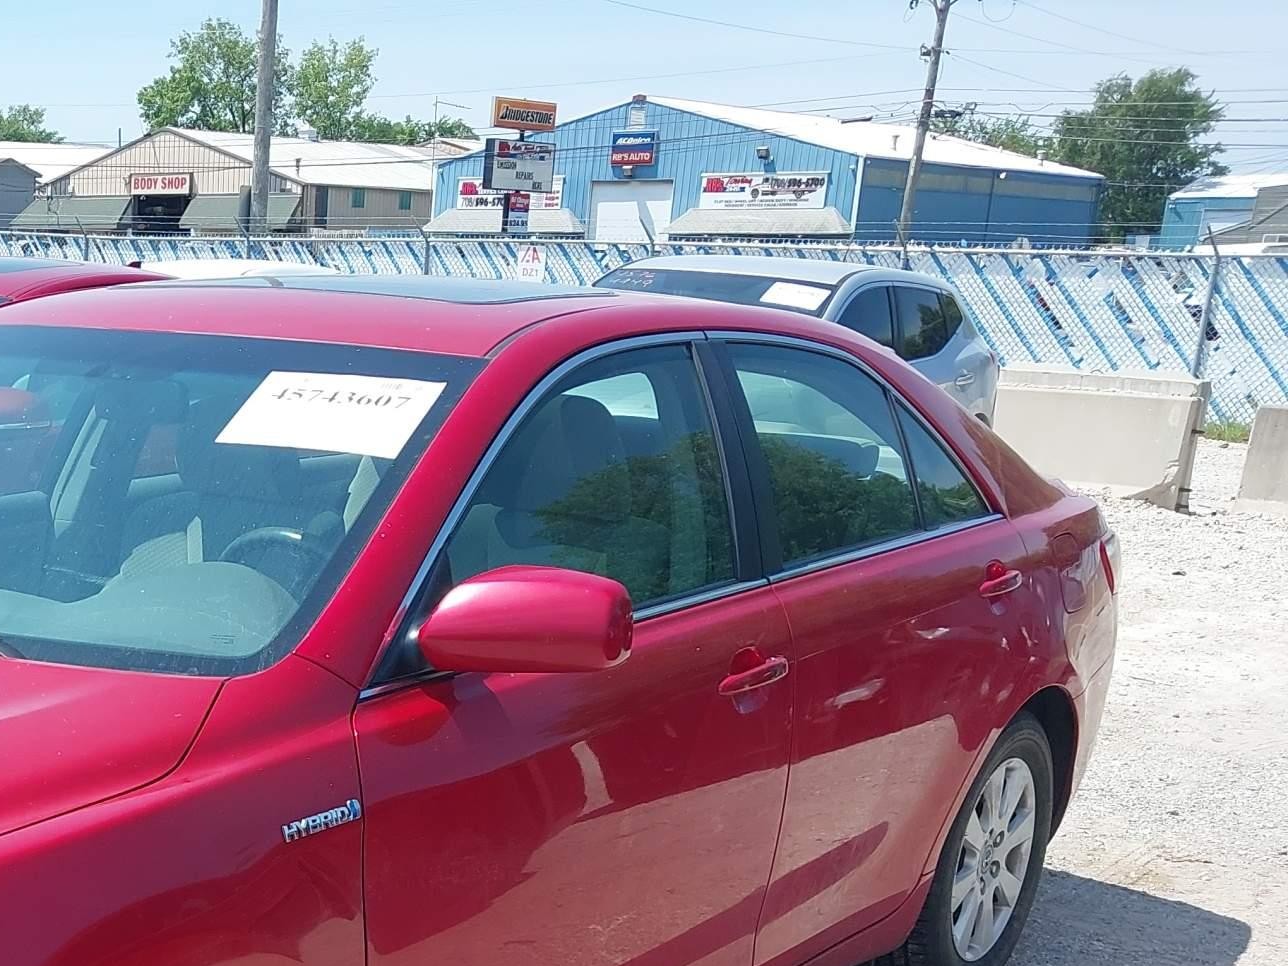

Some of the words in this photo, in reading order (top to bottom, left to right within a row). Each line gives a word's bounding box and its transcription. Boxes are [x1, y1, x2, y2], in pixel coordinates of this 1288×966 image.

[500, 105, 553, 124] BRIDGESTONE
[629, 153, 650, 161] AUTO
[134, 178, 158, 190] BODY
[161, 177, 187, 189] SHOP
[515, 171, 534, 180] REPAIRS
[272, 388, 412, 409] 45743607
[282, 805, 350, 843] HYBRID
